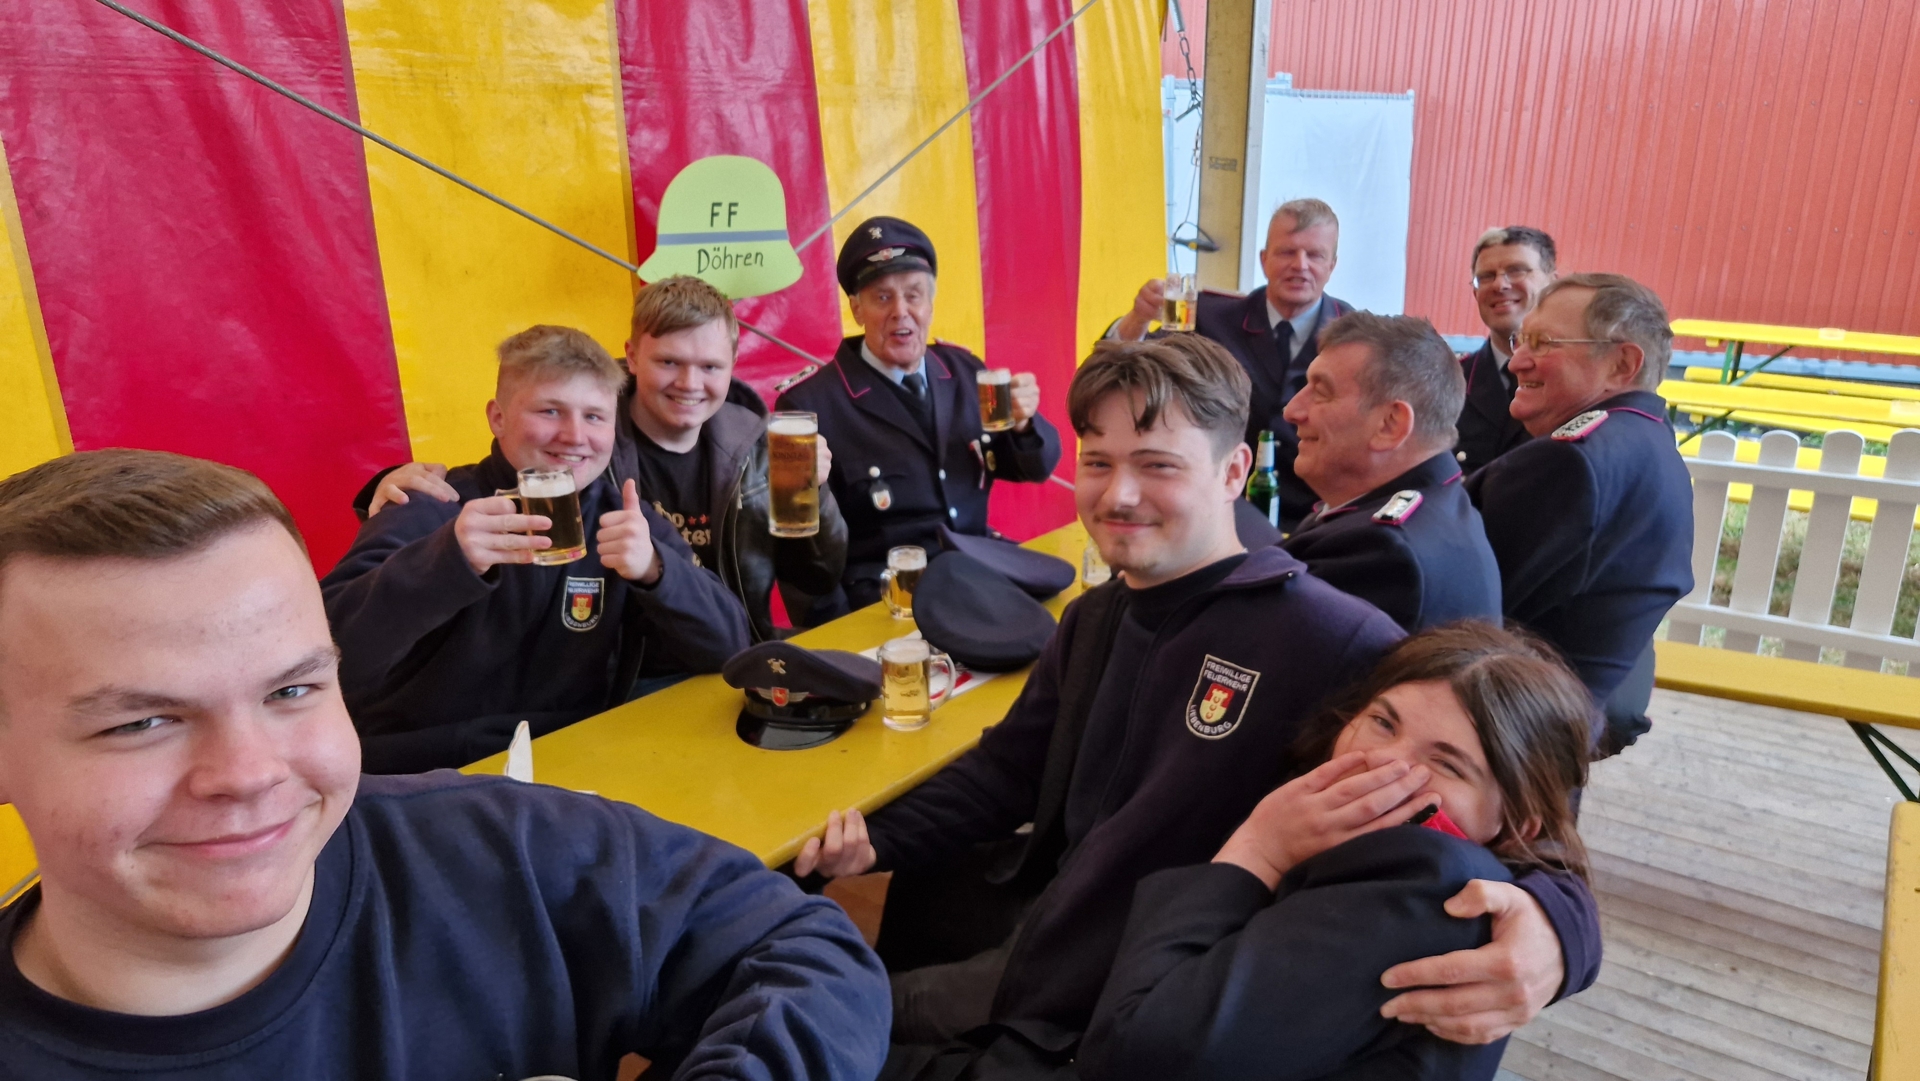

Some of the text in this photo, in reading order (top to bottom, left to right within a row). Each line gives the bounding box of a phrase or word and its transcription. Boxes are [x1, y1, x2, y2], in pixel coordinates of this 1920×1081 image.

[710, 202, 739, 228] FF
[697, 246, 764, 274] Döhren
[1203, 669, 1249, 692] FEUERWEHR
[1206, 660, 1252, 684] FREIWILLIGE
[1189, 704, 1232, 735] LIEBENBURG
